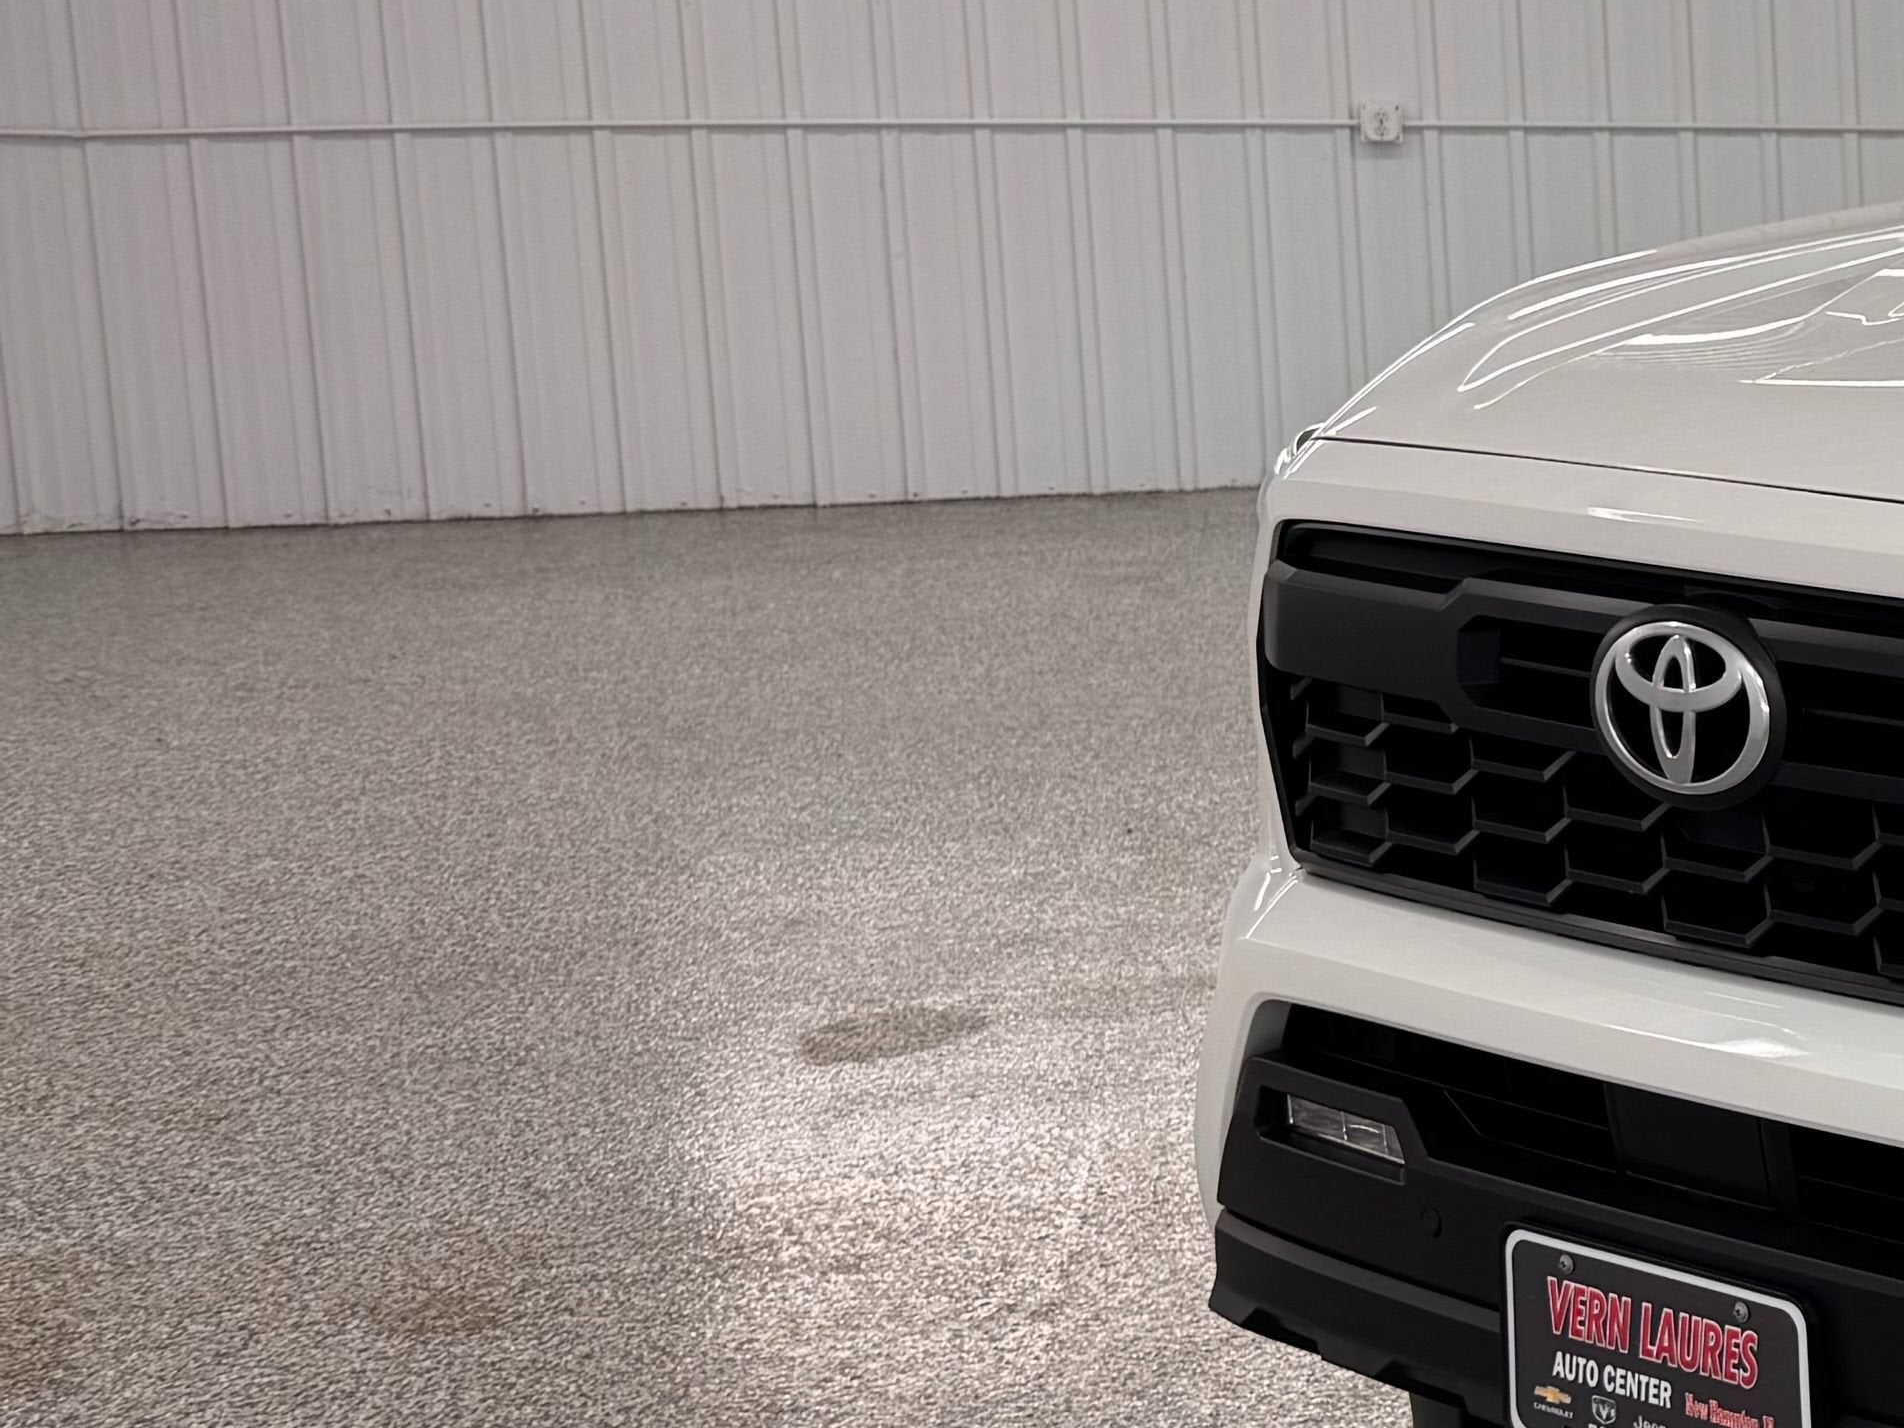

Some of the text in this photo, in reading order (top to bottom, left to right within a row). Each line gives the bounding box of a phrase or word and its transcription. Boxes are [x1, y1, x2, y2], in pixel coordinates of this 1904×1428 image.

[1547, 1275, 1759, 1390] VERN LAURES
[1552, 1351, 1673, 1409] AUTO CENTER
